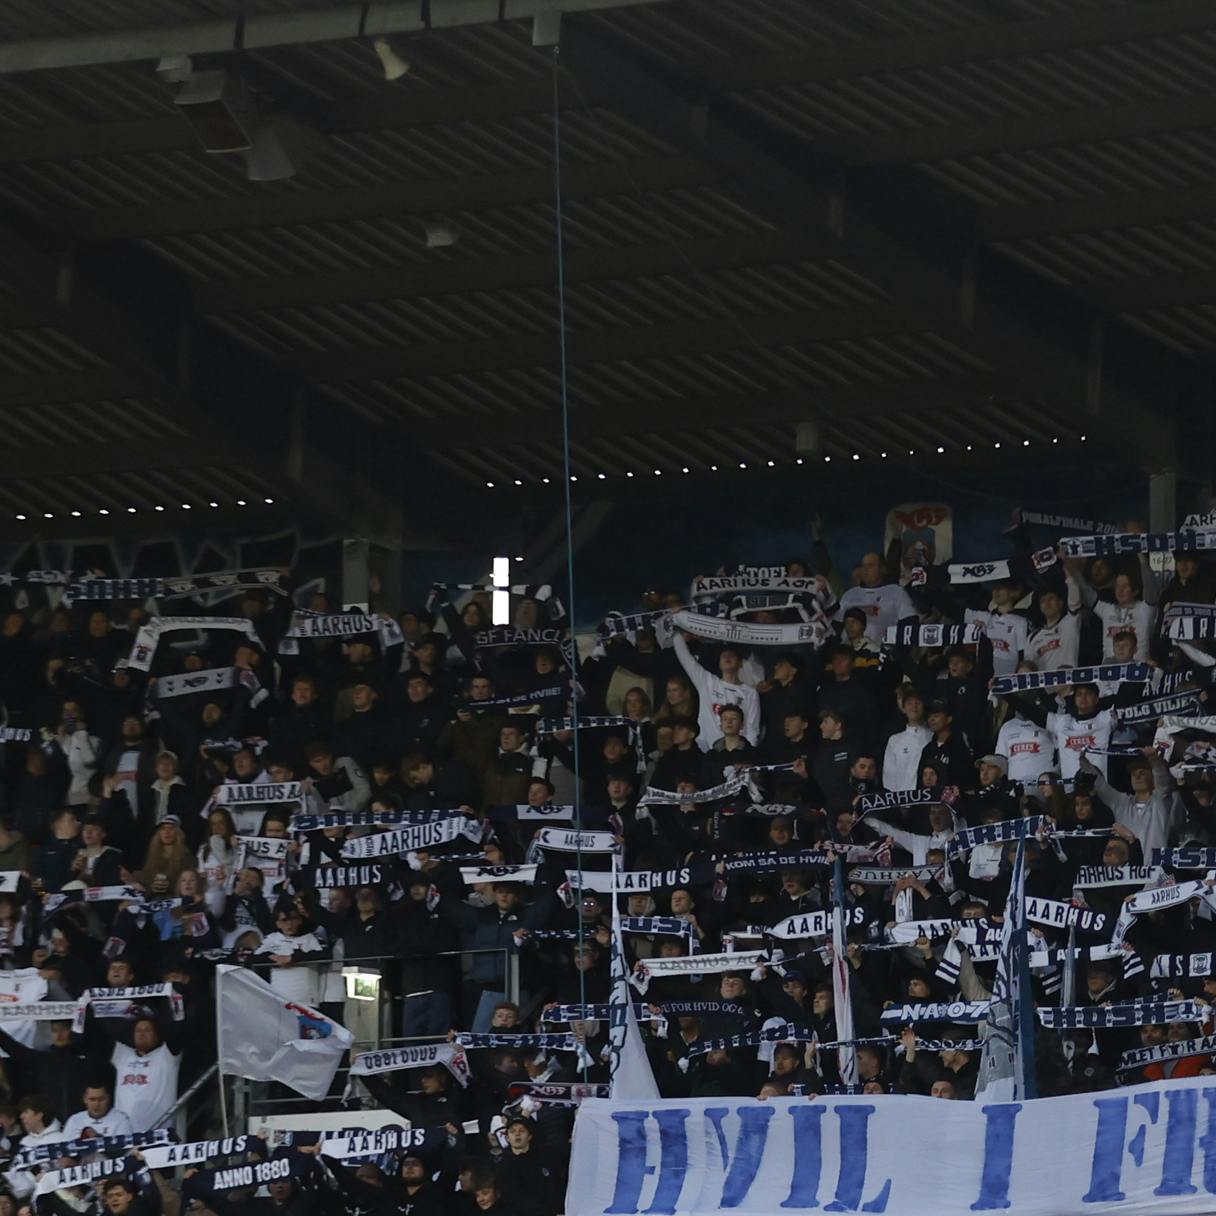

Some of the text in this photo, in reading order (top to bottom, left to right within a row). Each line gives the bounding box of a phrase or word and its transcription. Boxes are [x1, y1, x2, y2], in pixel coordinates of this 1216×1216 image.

[311, 614, 373, 635] AARHUS
[227, 785, 278, 803] AARHUS
[860, 788, 932, 810] AARHUS
[379, 824, 442, 852] AARHUS
[724, 859, 756, 871] KOM
[778, 855, 797, 866] DE
[314, 864, 382, 888] AARHUS
[610, 868, 691, 890] AARHUS
[1150, 886, 1181, 905] AARHUS
[1028, 900, 1106, 930] AARHUS
[167, 1136, 248, 1163] AARHUS
[348, 1130, 425, 1154] AARHUS
[603, 1096, 894, 1216] HVIL
[968, 1102, 1018, 1211] I
[58, 1158, 126, 1184] AARHUS
[213, 1158, 290, 1190] ANNO 1880
